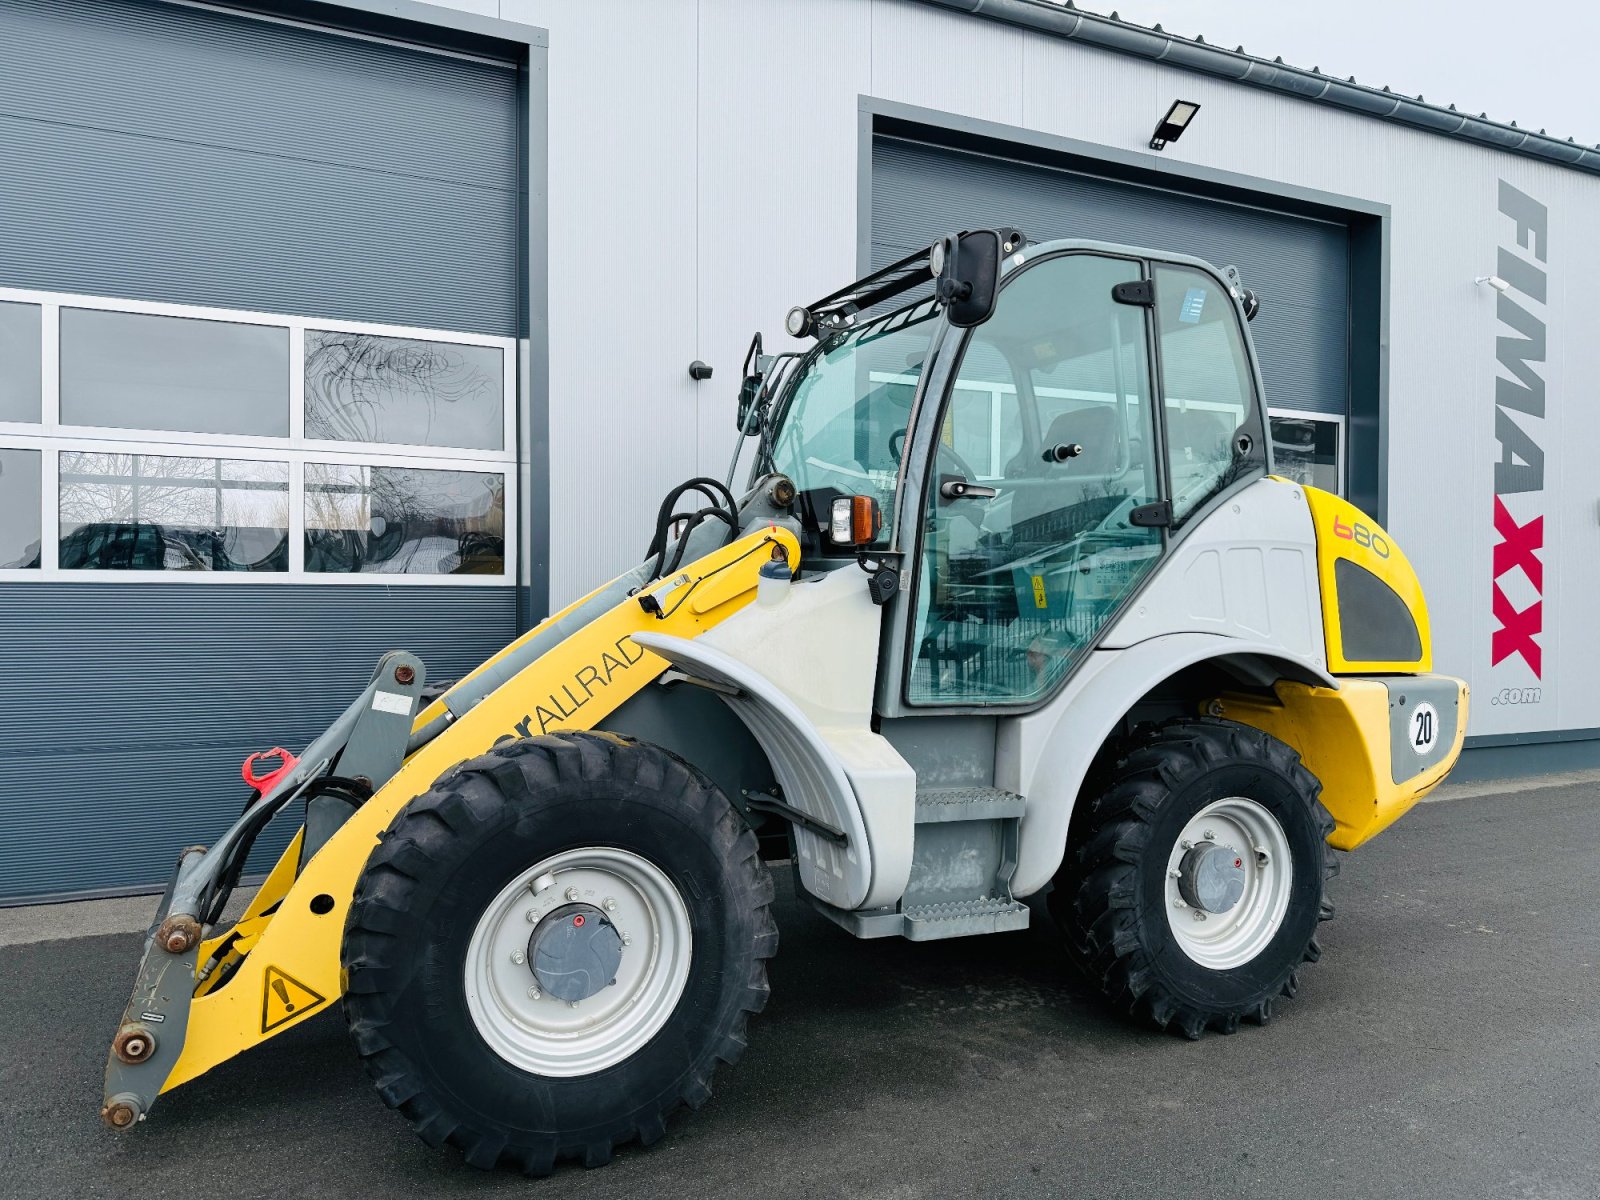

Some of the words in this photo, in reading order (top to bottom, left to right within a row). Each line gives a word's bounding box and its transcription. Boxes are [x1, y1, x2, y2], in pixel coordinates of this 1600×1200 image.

[1491, 177, 1548, 682] FIMAXX
[1333, 514, 1390, 559] 680
[1491, 687, 1541, 705] .com
[1415, 711, 1432, 746] 20
